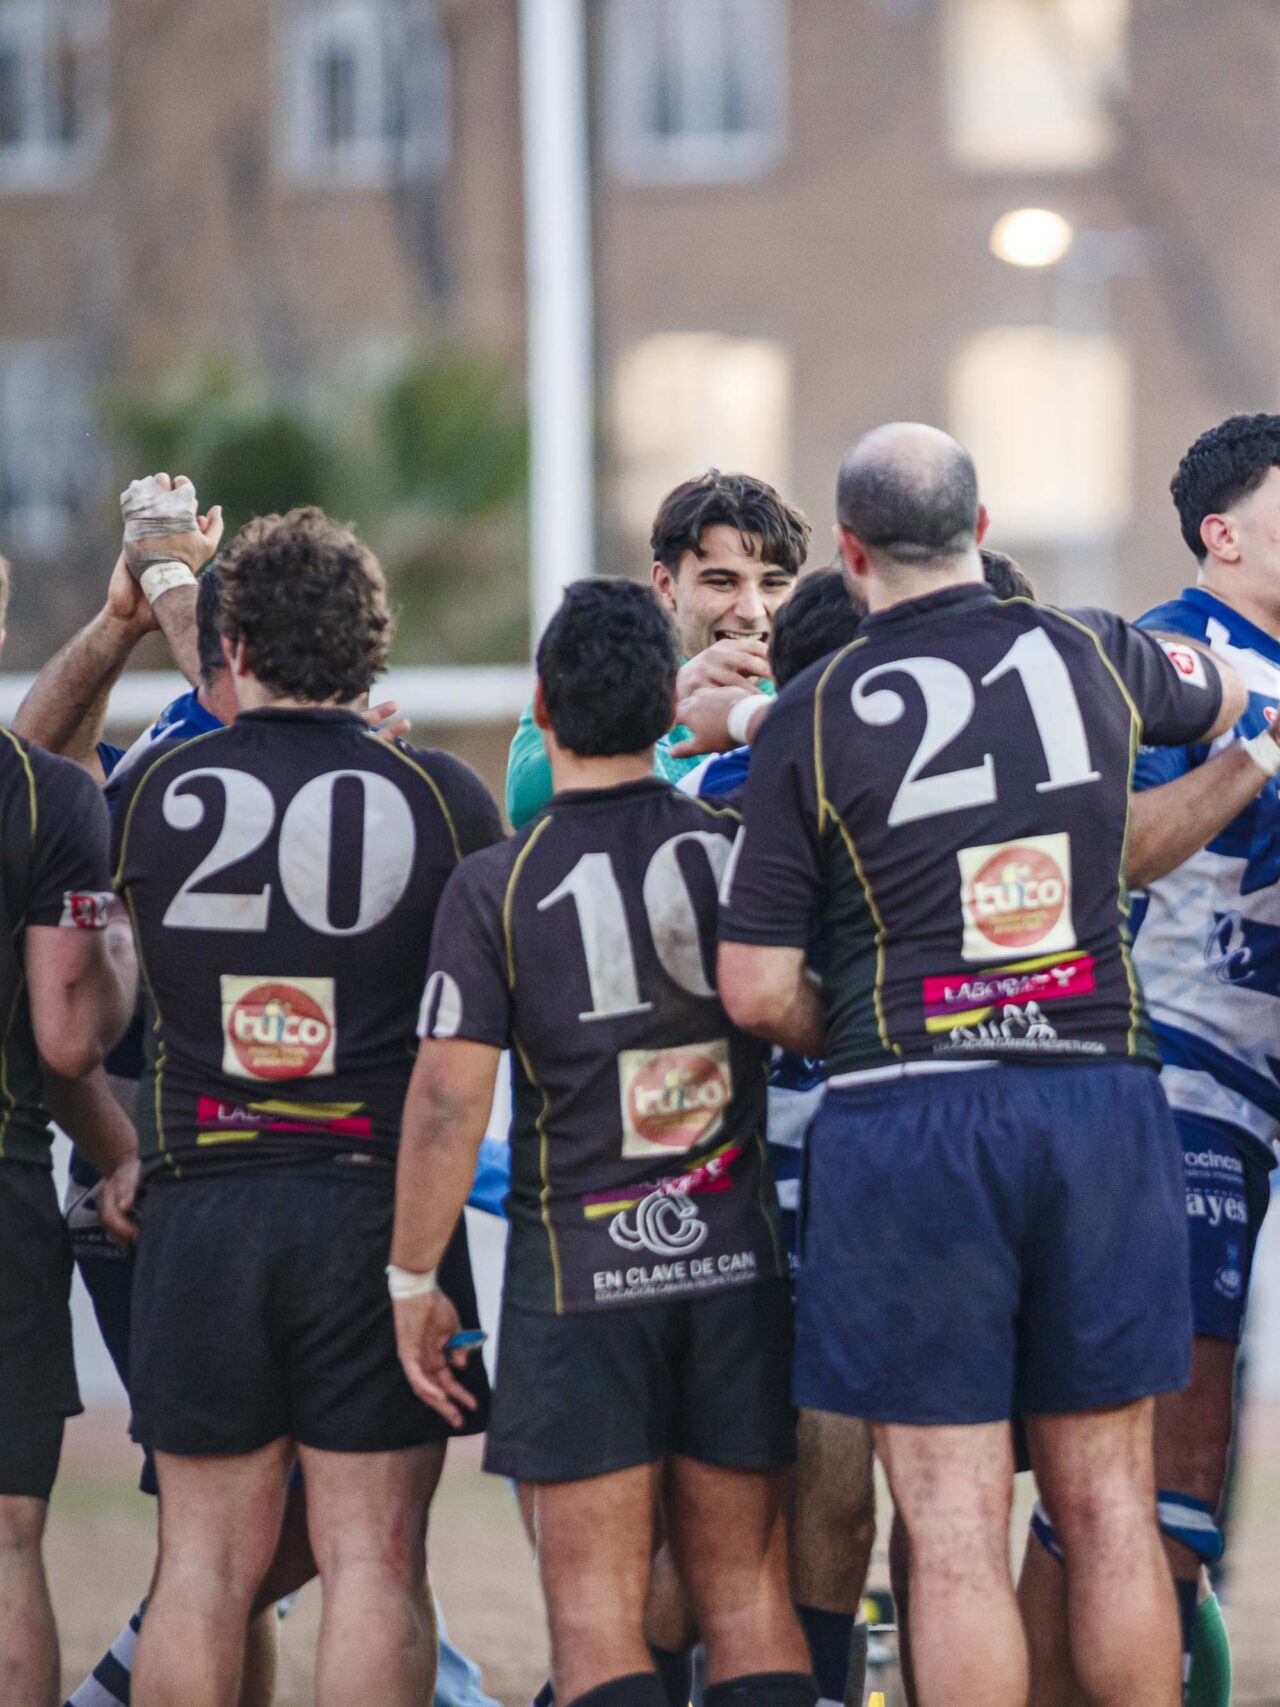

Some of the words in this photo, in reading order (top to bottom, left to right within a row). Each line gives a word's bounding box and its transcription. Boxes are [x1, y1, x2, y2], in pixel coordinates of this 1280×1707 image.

[850, 626, 1102, 826] 21
[162, 766, 417, 937] 20
[536, 830, 735, 1022] 10
[593, 1269, 624, 1290] EN
[626, 1260, 687, 1288] CLAVE
[690, 1257, 714, 1277] DE
[717, 1251, 757, 1271] CAN
